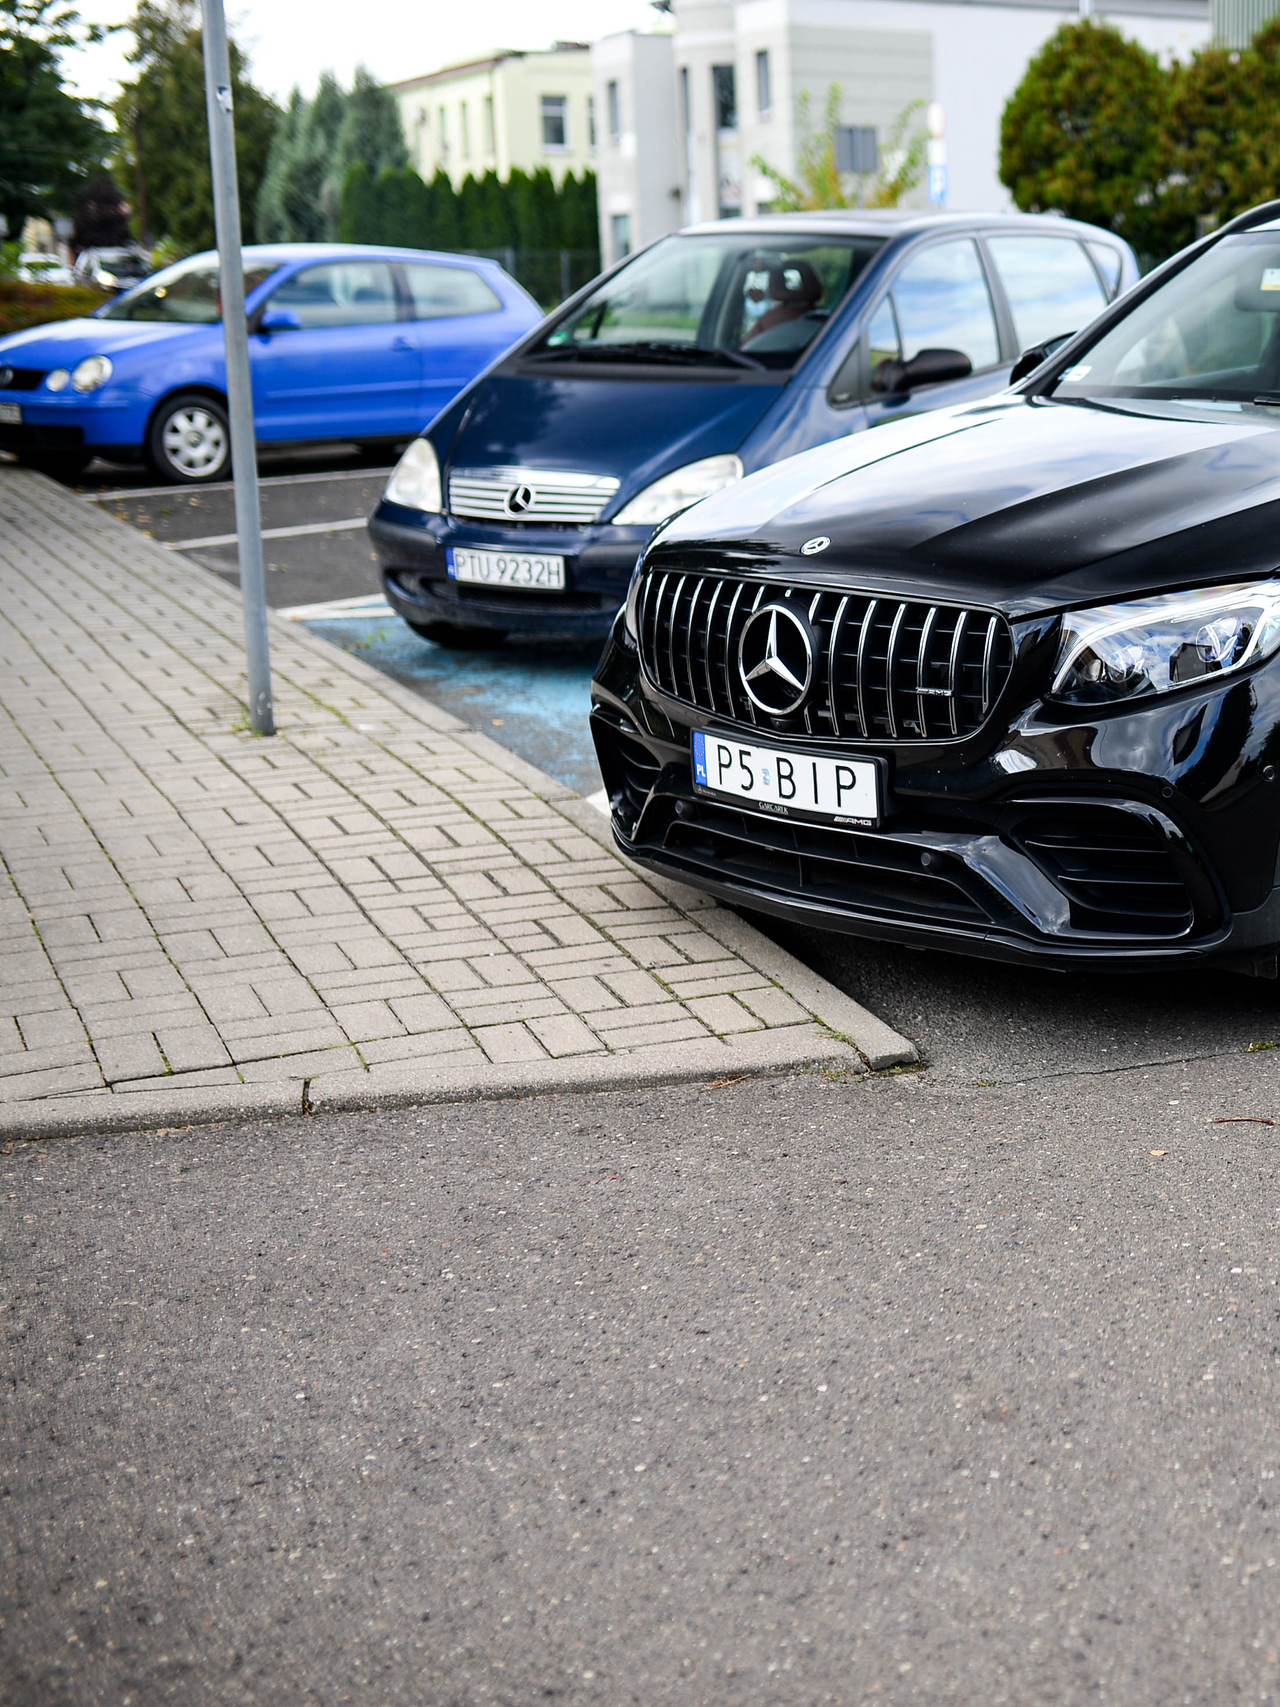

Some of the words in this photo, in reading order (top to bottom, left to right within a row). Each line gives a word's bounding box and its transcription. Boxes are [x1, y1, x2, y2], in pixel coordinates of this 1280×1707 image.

[455, 553, 490, 579] PTU
[496, 558, 561, 585] 9232H
[696, 763, 706, 778] PL
[716, 743, 754, 791] P5
[775, 757, 857, 808] BIP
[846, 817, 872, 826] AMG
